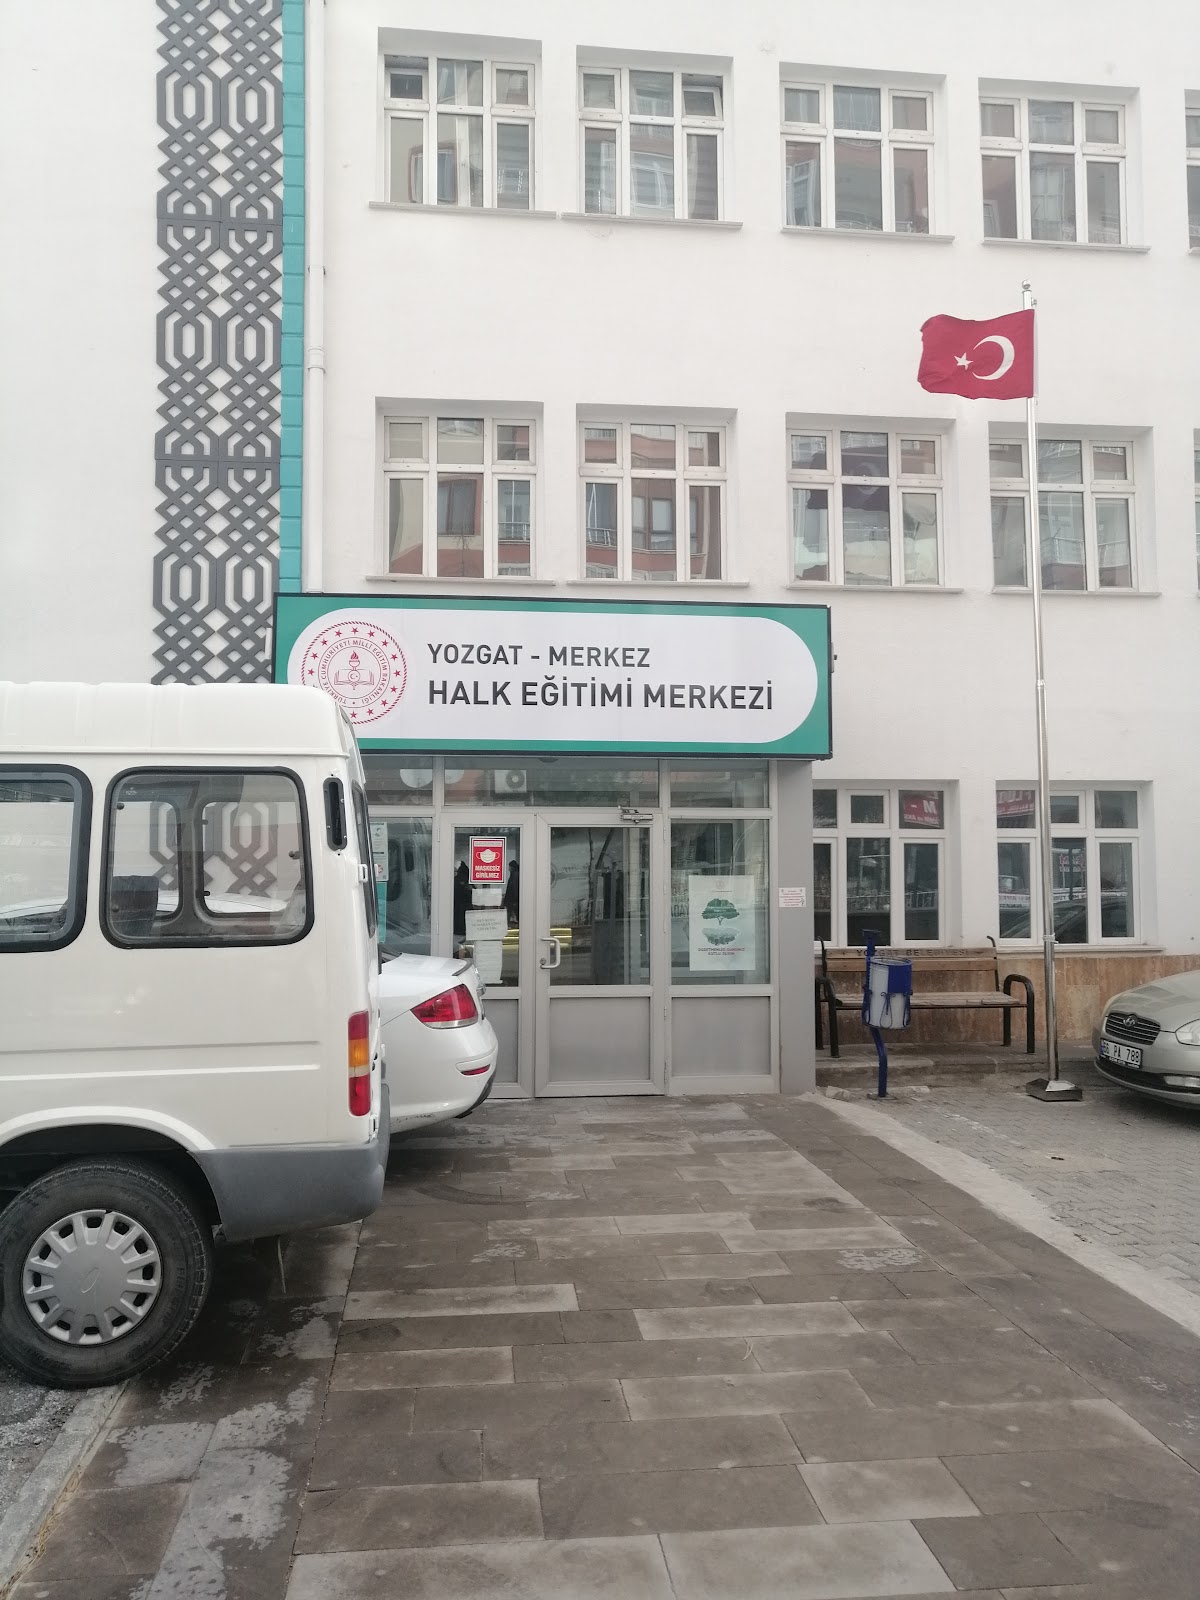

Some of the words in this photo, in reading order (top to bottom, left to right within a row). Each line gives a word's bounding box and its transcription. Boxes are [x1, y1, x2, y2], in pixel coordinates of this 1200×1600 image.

[352, 640, 373, 650] MİLLİ
[427, 643, 523, 665] YOZGAT
[549, 645, 650, 668] MERKEZ
[429, 680, 512, 706] HALK
[521, 674, 632, 708] EĞİTİMİ
[643, 680, 773, 710] MERKEZİ
[1113, 1045, 1122, 1058] PA
